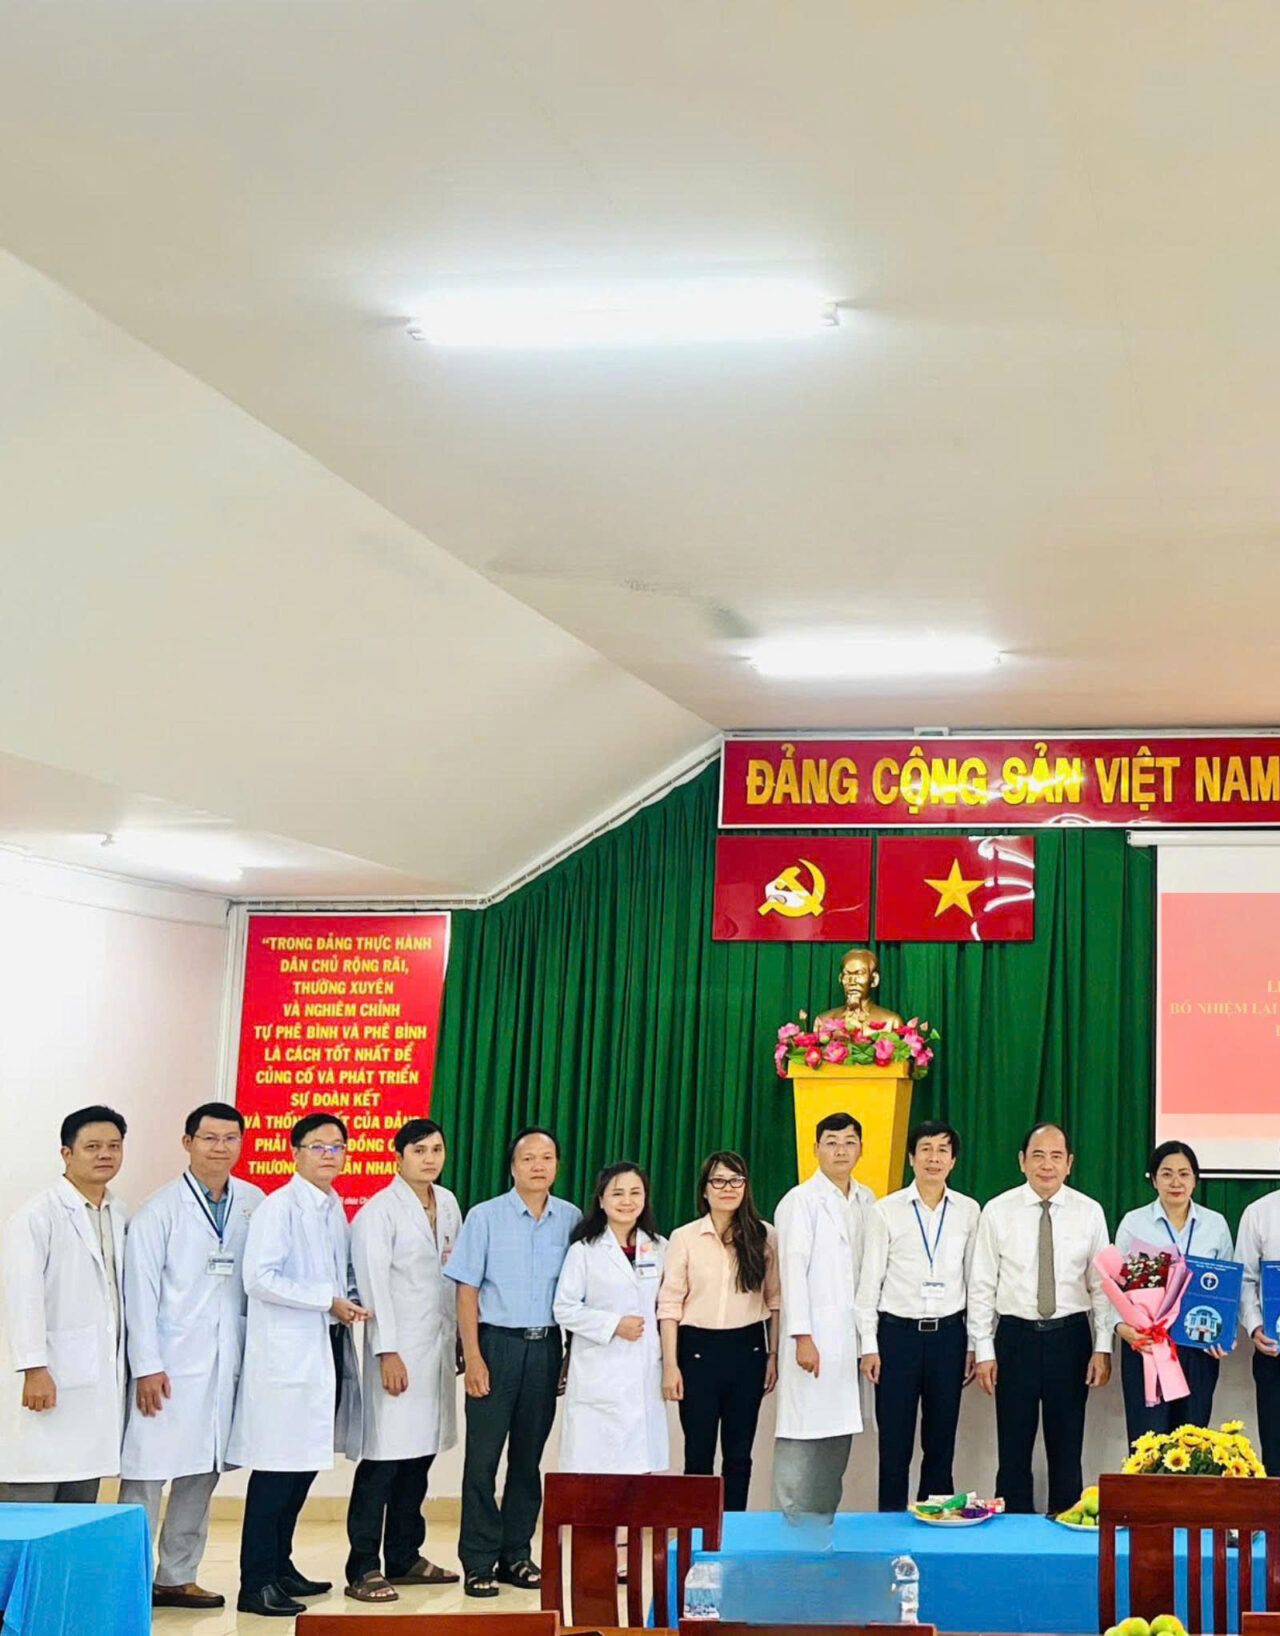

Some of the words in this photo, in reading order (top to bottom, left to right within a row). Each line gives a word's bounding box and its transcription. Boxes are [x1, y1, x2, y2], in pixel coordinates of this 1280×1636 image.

[747, 744, 858, 804] ĐẢNG
[873, 746, 990, 814] CỘNG
[1000, 742, 1085, 806] SẢN
[1095, 746, 1180, 810] VIỆT
[1196, 757, 1280, 801] NAM
[263, 937, 312, 950] “TRONG
[317, 933, 352, 950] ĐẢNG
[357, 935, 391, 952] THỰC
[396, 934, 432, 950] HÀNH
[281, 956, 308, 972] DÂN
[312, 955, 338, 972] CHỦ
[343, 956, 379, 974] RỘNG
[383, 956, 409, 974] RÃI,
[294, 979, 346, 995] THƯỜNG
[350, 978, 394, 995] XUYÊN
[284, 1001, 300, 1016] VÀ
[305, 1000, 356, 1017] NGHIÊM
[255, 1024, 272, 1041] TỰ
[276, 1023, 301, 1039] PHÊ
[307, 1023, 338, 1039] BÌNH
[343, 1023, 359, 1039] VÀ
[364, 1022, 390, 1039] PHÊ
[395, 1023, 427, 1039] BÌNH
[265, 1046, 281, 1061] LÀ
[286, 1045, 321, 1061] CÁCH
[325, 1043, 351, 1061] TỐT
[355, 1044, 390, 1061] NHẤT
[395, 1042, 414, 1061] ĐỂ
[256, 1066, 292, 1083] CỦNG
[295, 1066, 314, 1084] CỐ
[318, 1068, 335, 1084] VÀ
[339, 1068, 374, 1084] PHÁT
[379, 1064, 419, 1084] TRIỂN
[291, 1091, 310, 1109] SỰ
[313, 1091, 349, 1106] ĐOÀN
[354, 1088, 380, 1106] KẾT
[266, 1112, 298, 1128] THỐN
[354, 1111, 380, 1129] CỦA
[256, 1134, 286, 1151] PHẢI
[348, 1132, 384, 1151] ĐỒNG
[338, 1156, 362, 1174] ẪN
